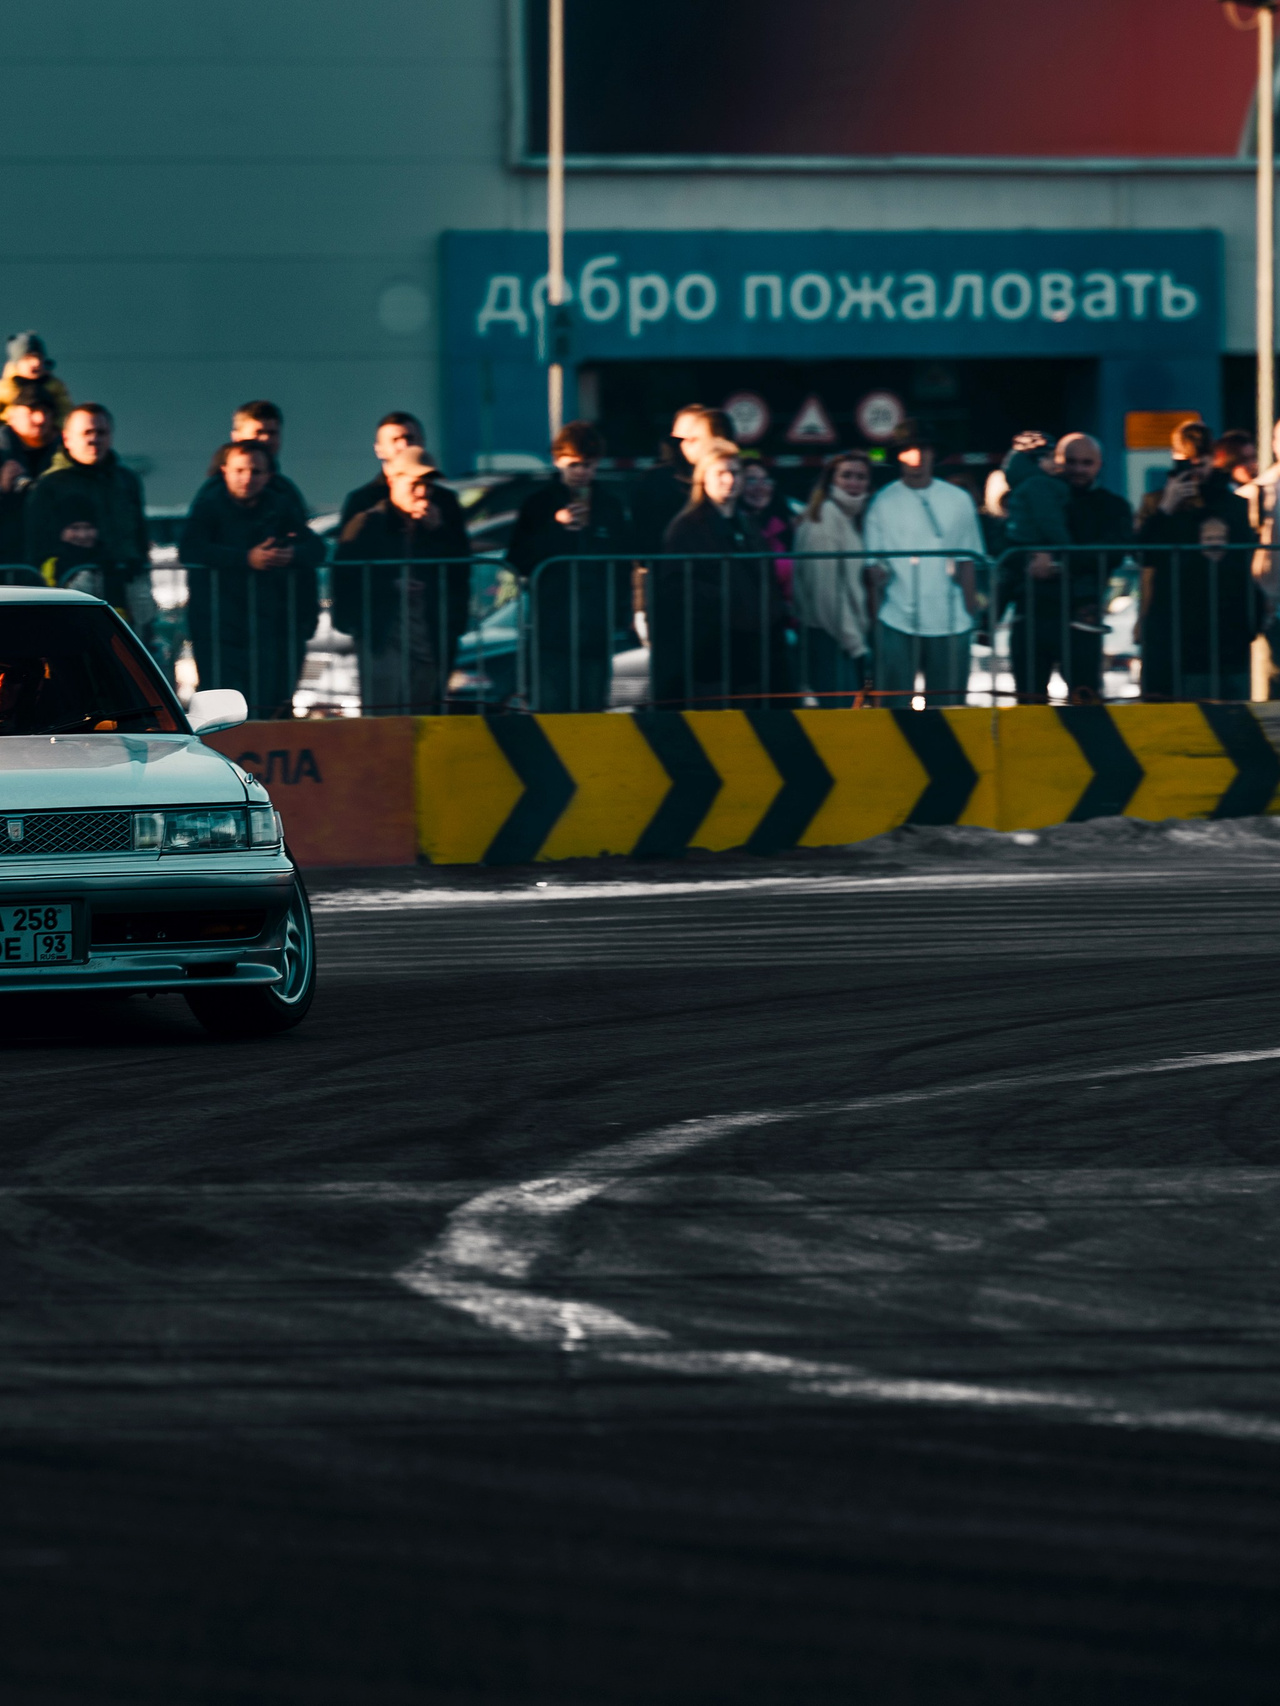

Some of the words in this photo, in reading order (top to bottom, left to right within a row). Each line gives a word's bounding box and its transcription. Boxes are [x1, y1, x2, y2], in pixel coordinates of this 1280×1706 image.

[742, 271, 1200, 320] пожаловать
[13, 907, 58, 931] 258
[42, 934, 66, 954] 93
